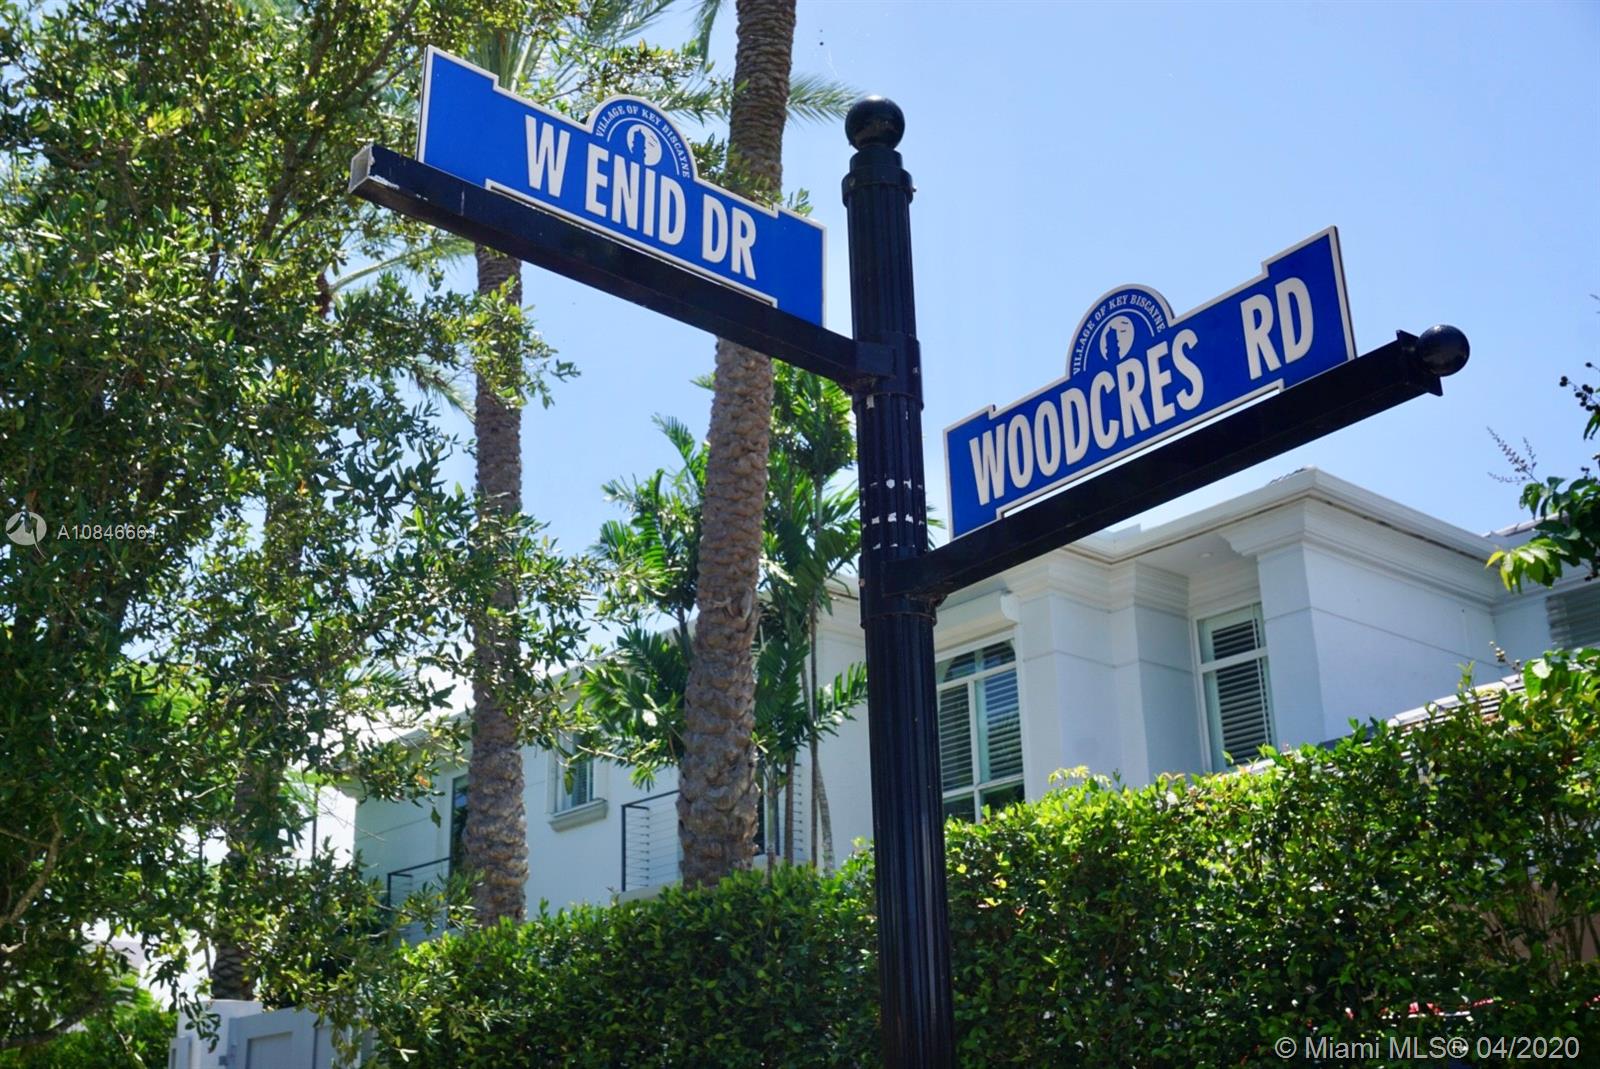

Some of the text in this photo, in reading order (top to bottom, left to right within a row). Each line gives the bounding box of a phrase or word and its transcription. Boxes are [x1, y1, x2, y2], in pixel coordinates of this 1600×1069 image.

[525, 114, 757, 280] W ENID DR
[596, 105, 690, 178] VILLAGE OF KEY BISCAYNE
[968, 277, 1314, 506] WOODCRES RD
[1073, 294, 1166, 375] VILLAGE OF KEY BISCAYNE
